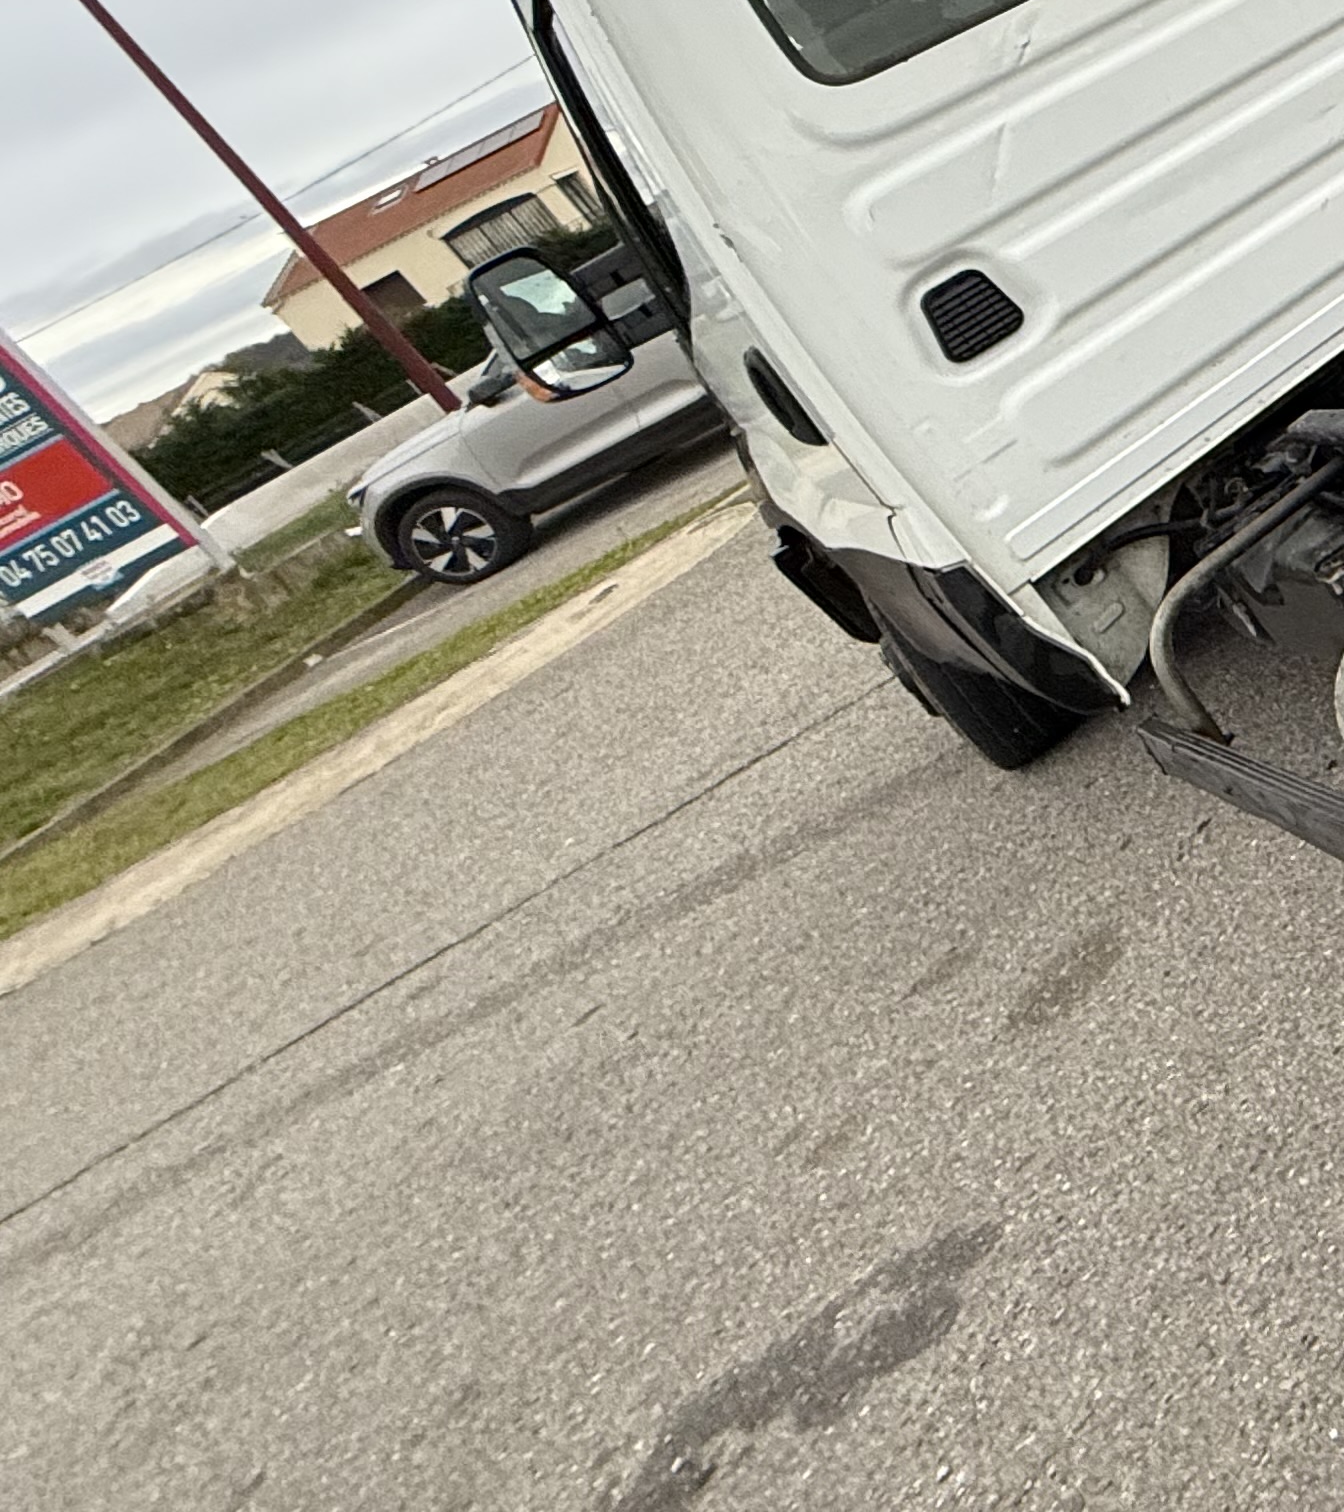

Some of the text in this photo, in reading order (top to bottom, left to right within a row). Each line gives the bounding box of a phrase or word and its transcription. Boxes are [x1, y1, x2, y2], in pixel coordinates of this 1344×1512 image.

[0, 559, 32, 587] 04
[22, 543, 60, 572] 75
[49, 528, 83, 558] 07
[80, 515, 113, 541] 41
[105, 500, 141, 527] 03
